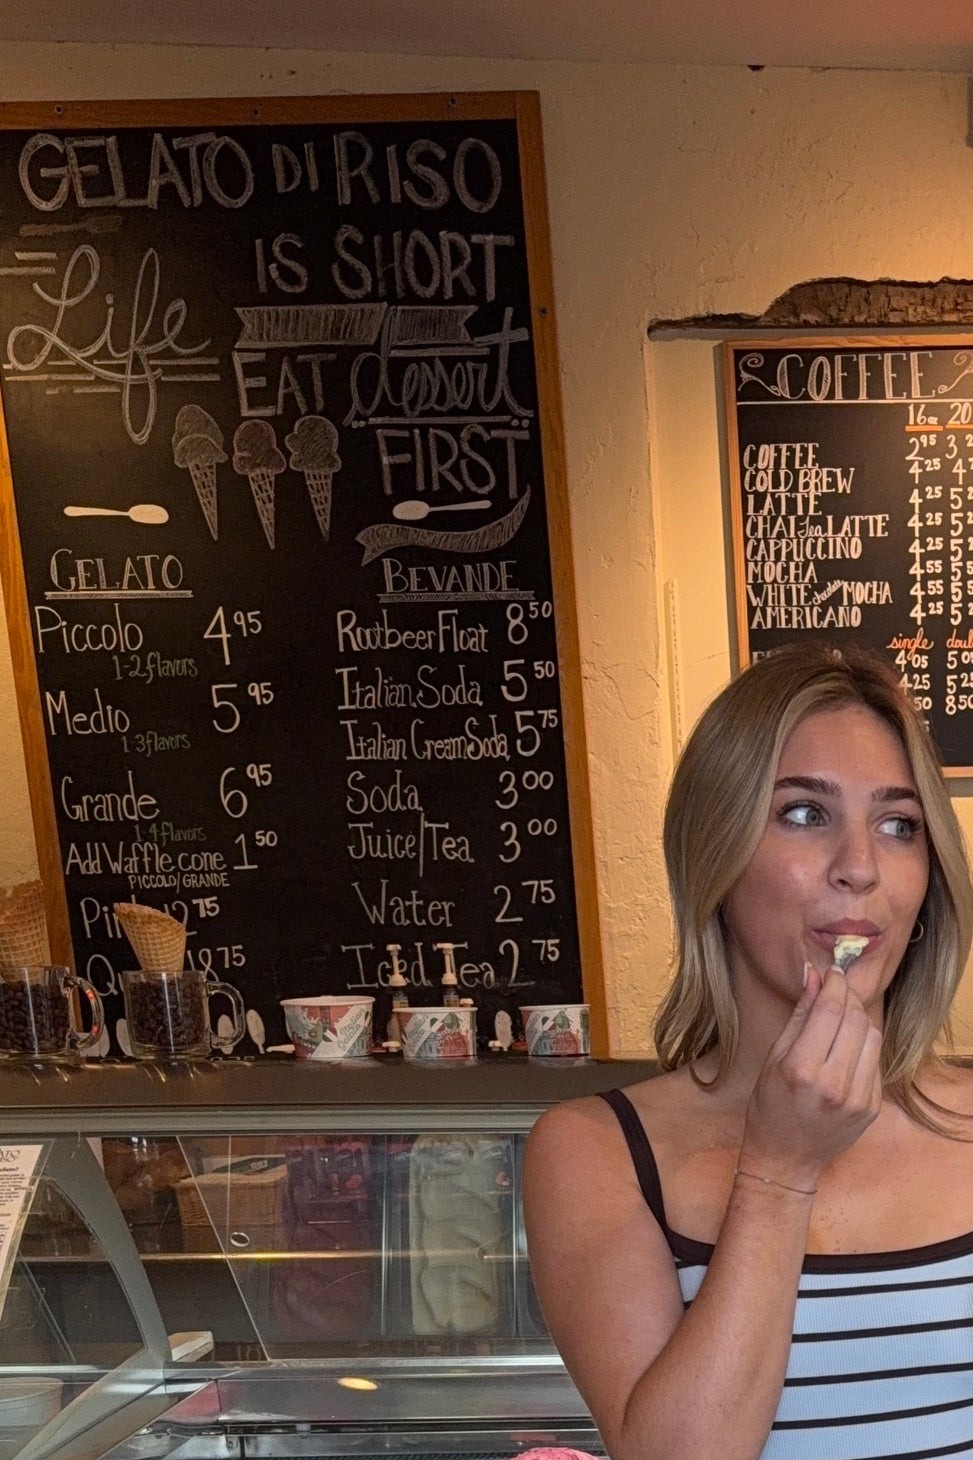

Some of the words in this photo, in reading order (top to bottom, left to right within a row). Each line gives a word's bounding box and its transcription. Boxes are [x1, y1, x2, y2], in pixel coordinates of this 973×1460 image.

[18, 132, 254, 211] GELATO
[271, 141, 319, 193] DI
[333, 131, 502, 213] RISO
[255, 231, 308, 294] IS
[331, 224, 515, 302] SHORT
[6, 244, 212, 444] Life
[232, 350, 337, 417] EAT
[777, 352, 936, 401] COFFEE
[376, 423, 531, 500] FIRST
[743, 443, 819, 470] COFFEE
[744, 468, 793, 494] COLD
[799, 467, 855, 494] BREW
[746, 515, 796, 539] CHAI
[798, 518, 827, 538] Tea
[826, 514, 889, 538] LATTE
[747, 493, 822, 516] LATTE
[50, 548, 183, 592] GELATO
[746, 537, 863, 561] CAPPUCCINO
[381, 558, 520, 593] BEVANDE
[746, 583, 812, 607] WHITE
[843, 580, 893, 606] MOCHA
[747, 561, 818, 584] MOCHA
[34, 602, 144, 653] Piccolo
[336, 609, 436, 653] Rootbeer
[437, 608, 489, 653] Float
[750, 605, 862, 630] AMERICANO
[886, 627, 934, 661] single
[145, 651, 198, 684] flavors
[335, 666, 417, 710] Italian
[416, 665, 483, 709] Soda
[45, 688, 130, 736] Medio
[145, 730, 191, 758] flavors
[340, 719, 407, 761] Italian
[411, 719, 467, 760] Cream
[465, 715, 511, 762] Soda
[61, 770, 160, 822] Grande
[346, 769, 424, 815] Soda
[157, 821, 208, 847] flavors
[65, 842, 103, 875] Add
[101, 842, 176, 875] Waffle
[177, 850, 227, 873] cone
[351, 879, 456, 928] Water
[341, 942, 433, 988] Iced
[432, 941, 496, 989] Tea
